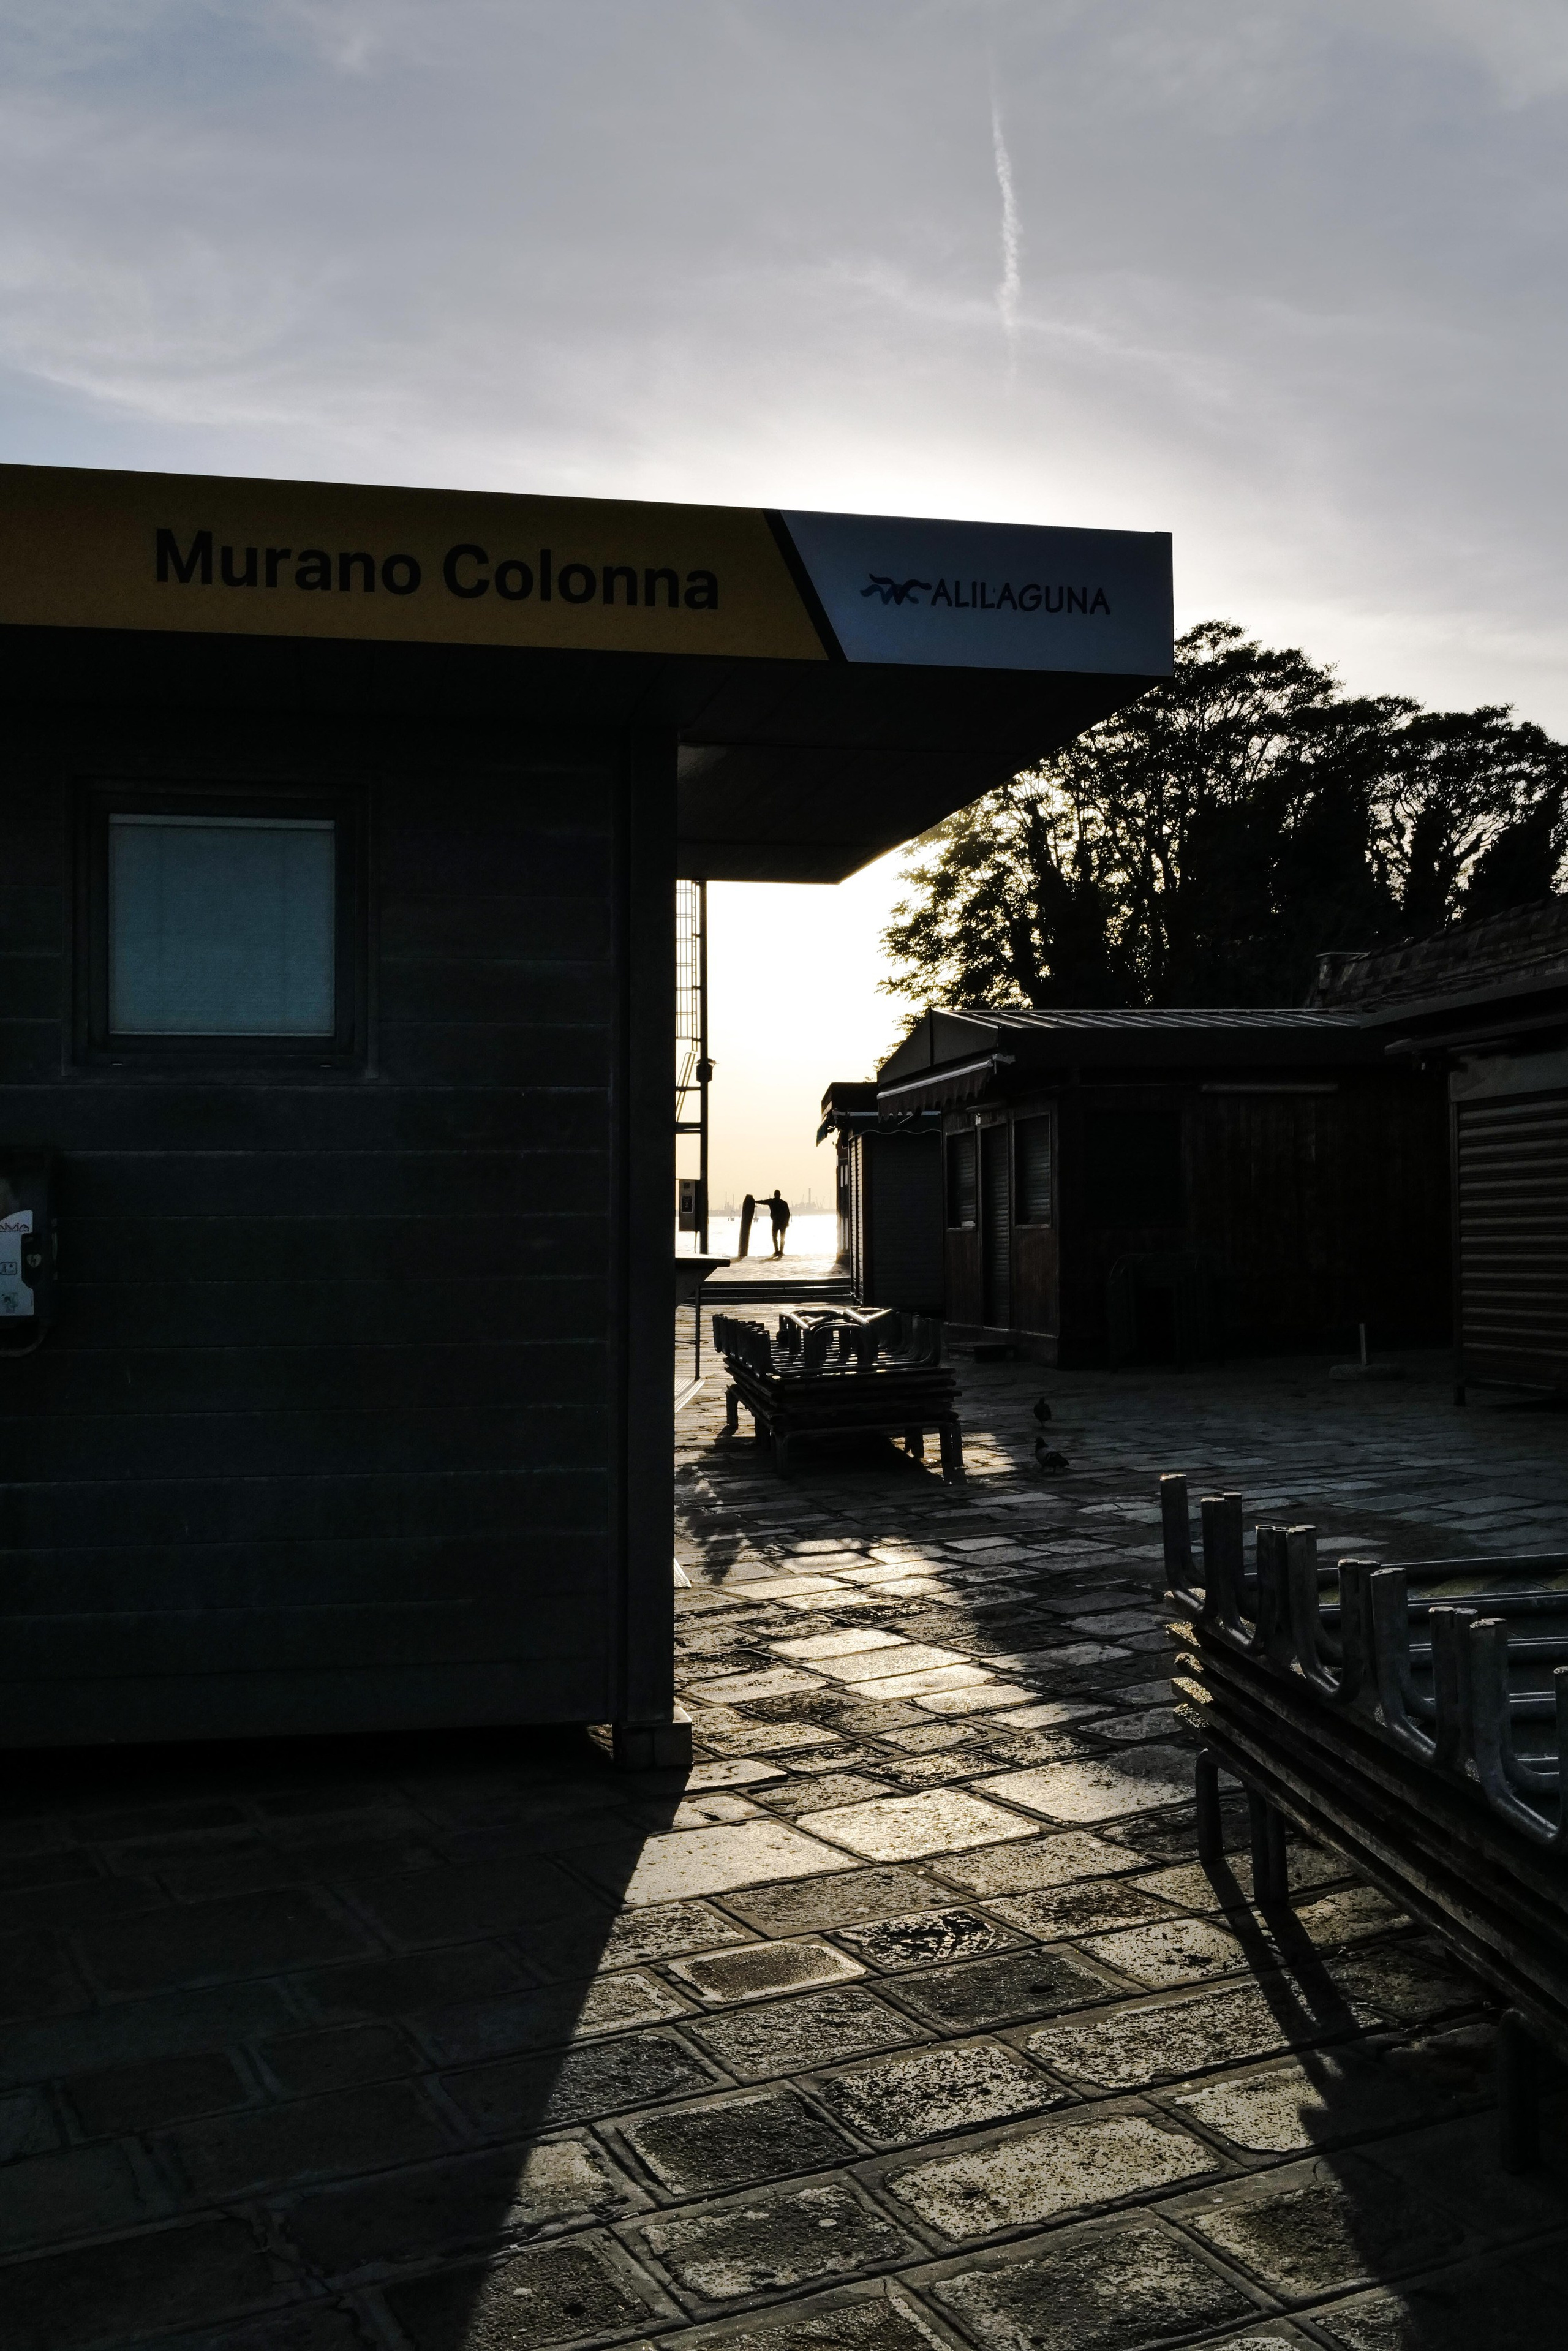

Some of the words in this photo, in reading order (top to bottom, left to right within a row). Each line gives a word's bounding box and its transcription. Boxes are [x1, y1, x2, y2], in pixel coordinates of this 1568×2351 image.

[157, 528, 421, 595] Murano
[443, 543, 719, 610] Colonna
[931, 578, 1111, 615] ALILAGUNA
